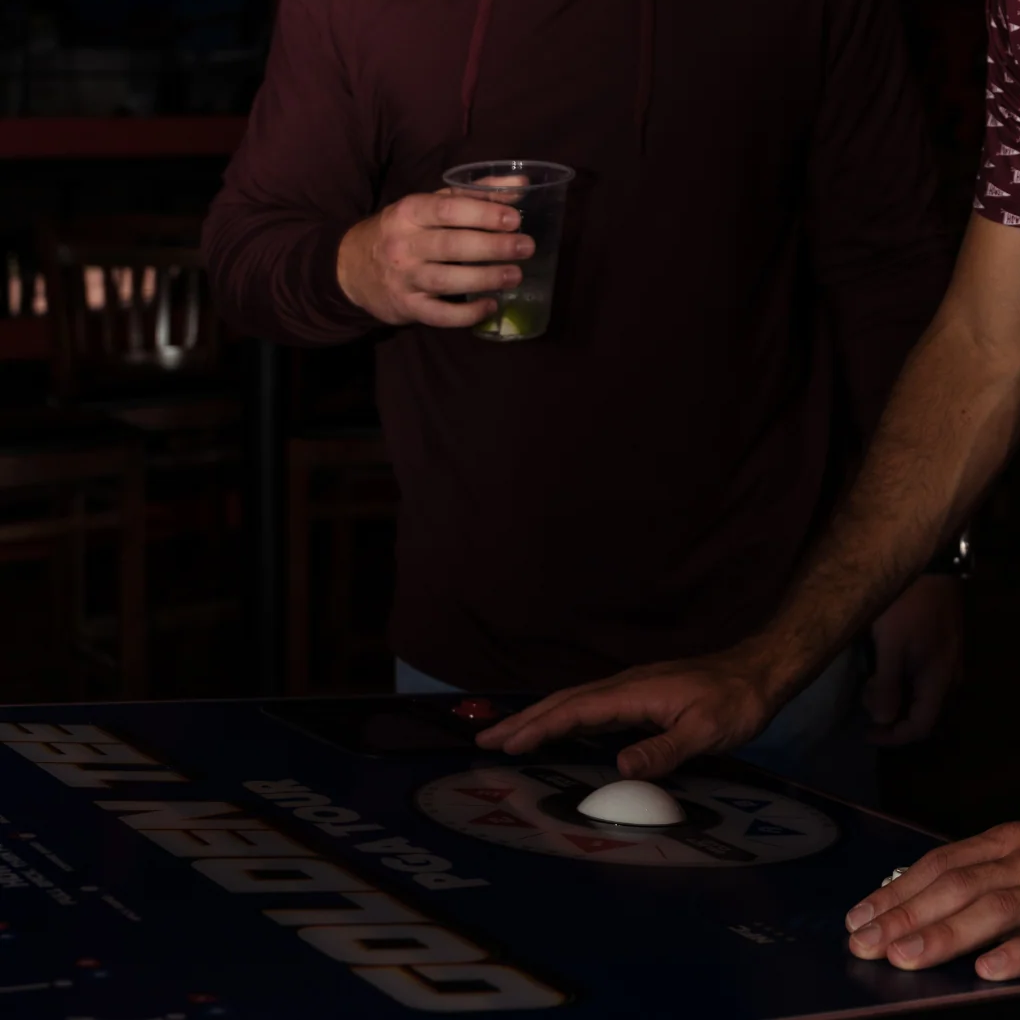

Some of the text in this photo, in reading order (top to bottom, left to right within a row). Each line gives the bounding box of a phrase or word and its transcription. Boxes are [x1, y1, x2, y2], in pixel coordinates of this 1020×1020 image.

[0, 721, 569, 1013] GOLDEN TEE
[242, 778, 492, 891] PGA TOUR
